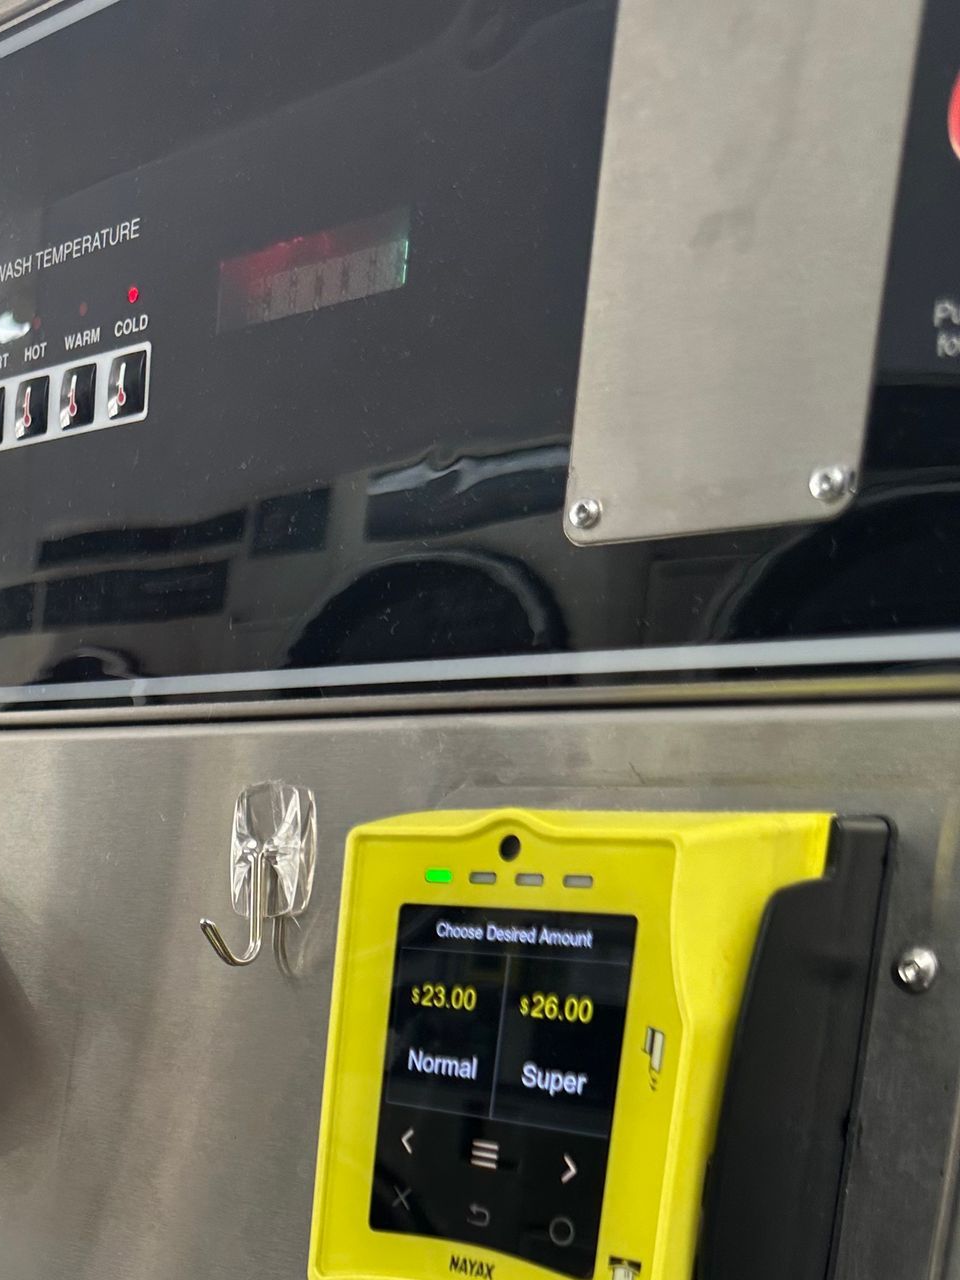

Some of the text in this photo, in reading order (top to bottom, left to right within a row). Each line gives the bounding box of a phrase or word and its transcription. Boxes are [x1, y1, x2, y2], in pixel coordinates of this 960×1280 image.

[35, 217, 141, 270] TEMPERATURE
[24, 342, 48, 362] HOT
[64, 327, 101, 350] WARM
[114, 314, 149, 337] COLD
[436, 922, 593, 949] Choose Desired Amount
[410, 983, 594, 1025] $23.00 $26.00
[407, 1047, 587, 1096] Normal Super
[449, 1254, 495, 1280] NAYAX
